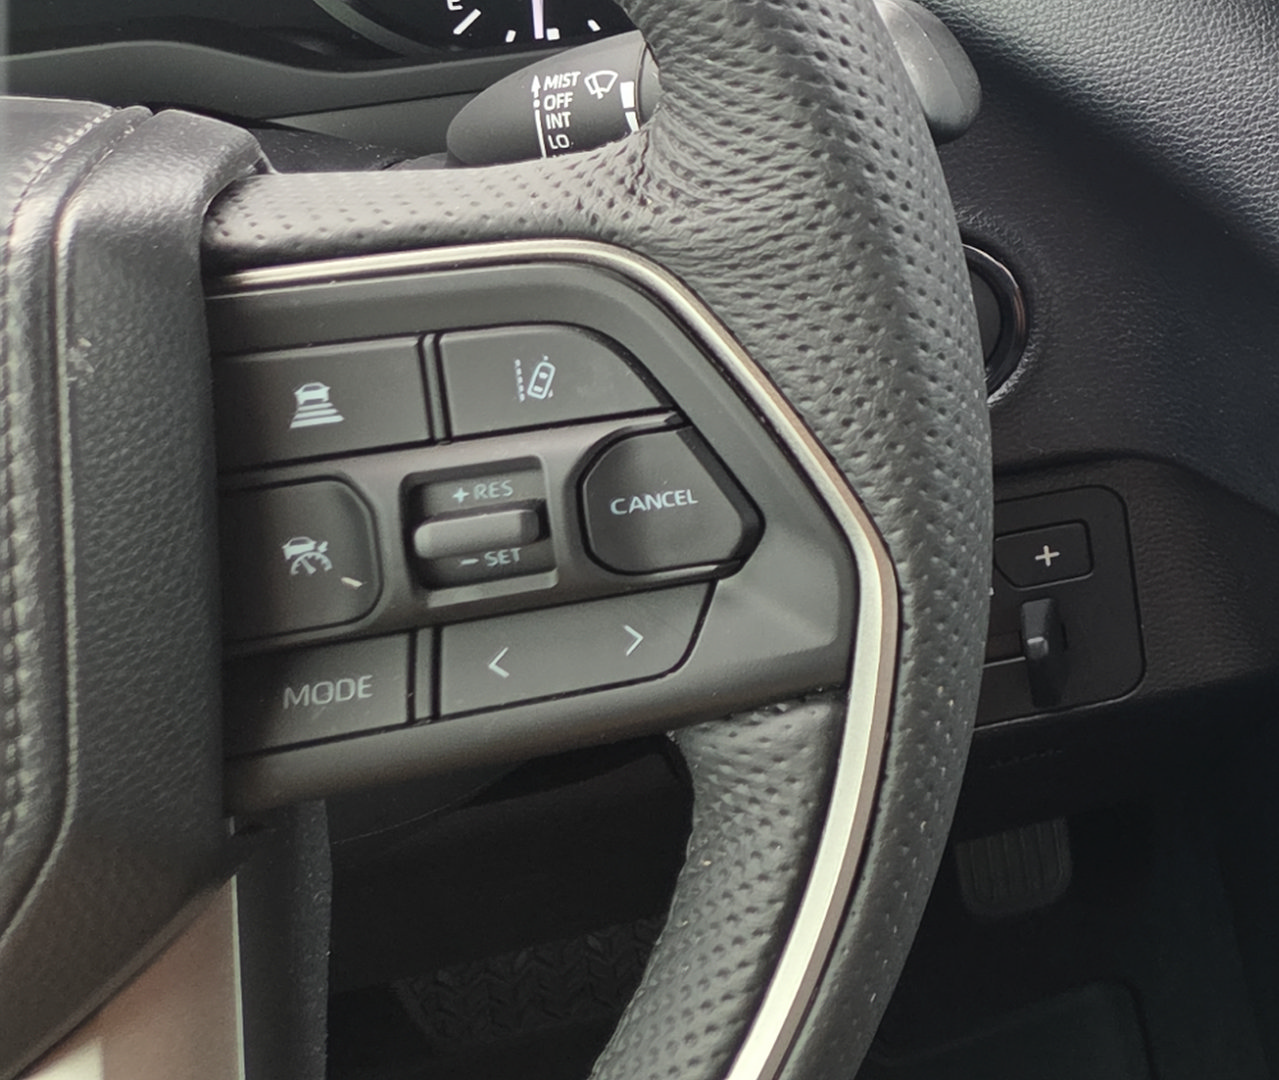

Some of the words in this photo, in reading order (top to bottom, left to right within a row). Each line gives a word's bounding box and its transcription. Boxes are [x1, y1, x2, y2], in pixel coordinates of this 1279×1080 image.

[543, 71, 581, 91] MIST
[543, 91, 574, 111] OFF
[545, 111, 571, 130] INT
[547, 133, 570, 150] LO
[610, 488, 699, 516] CANCEL
[282, 674, 374, 710] MODE
